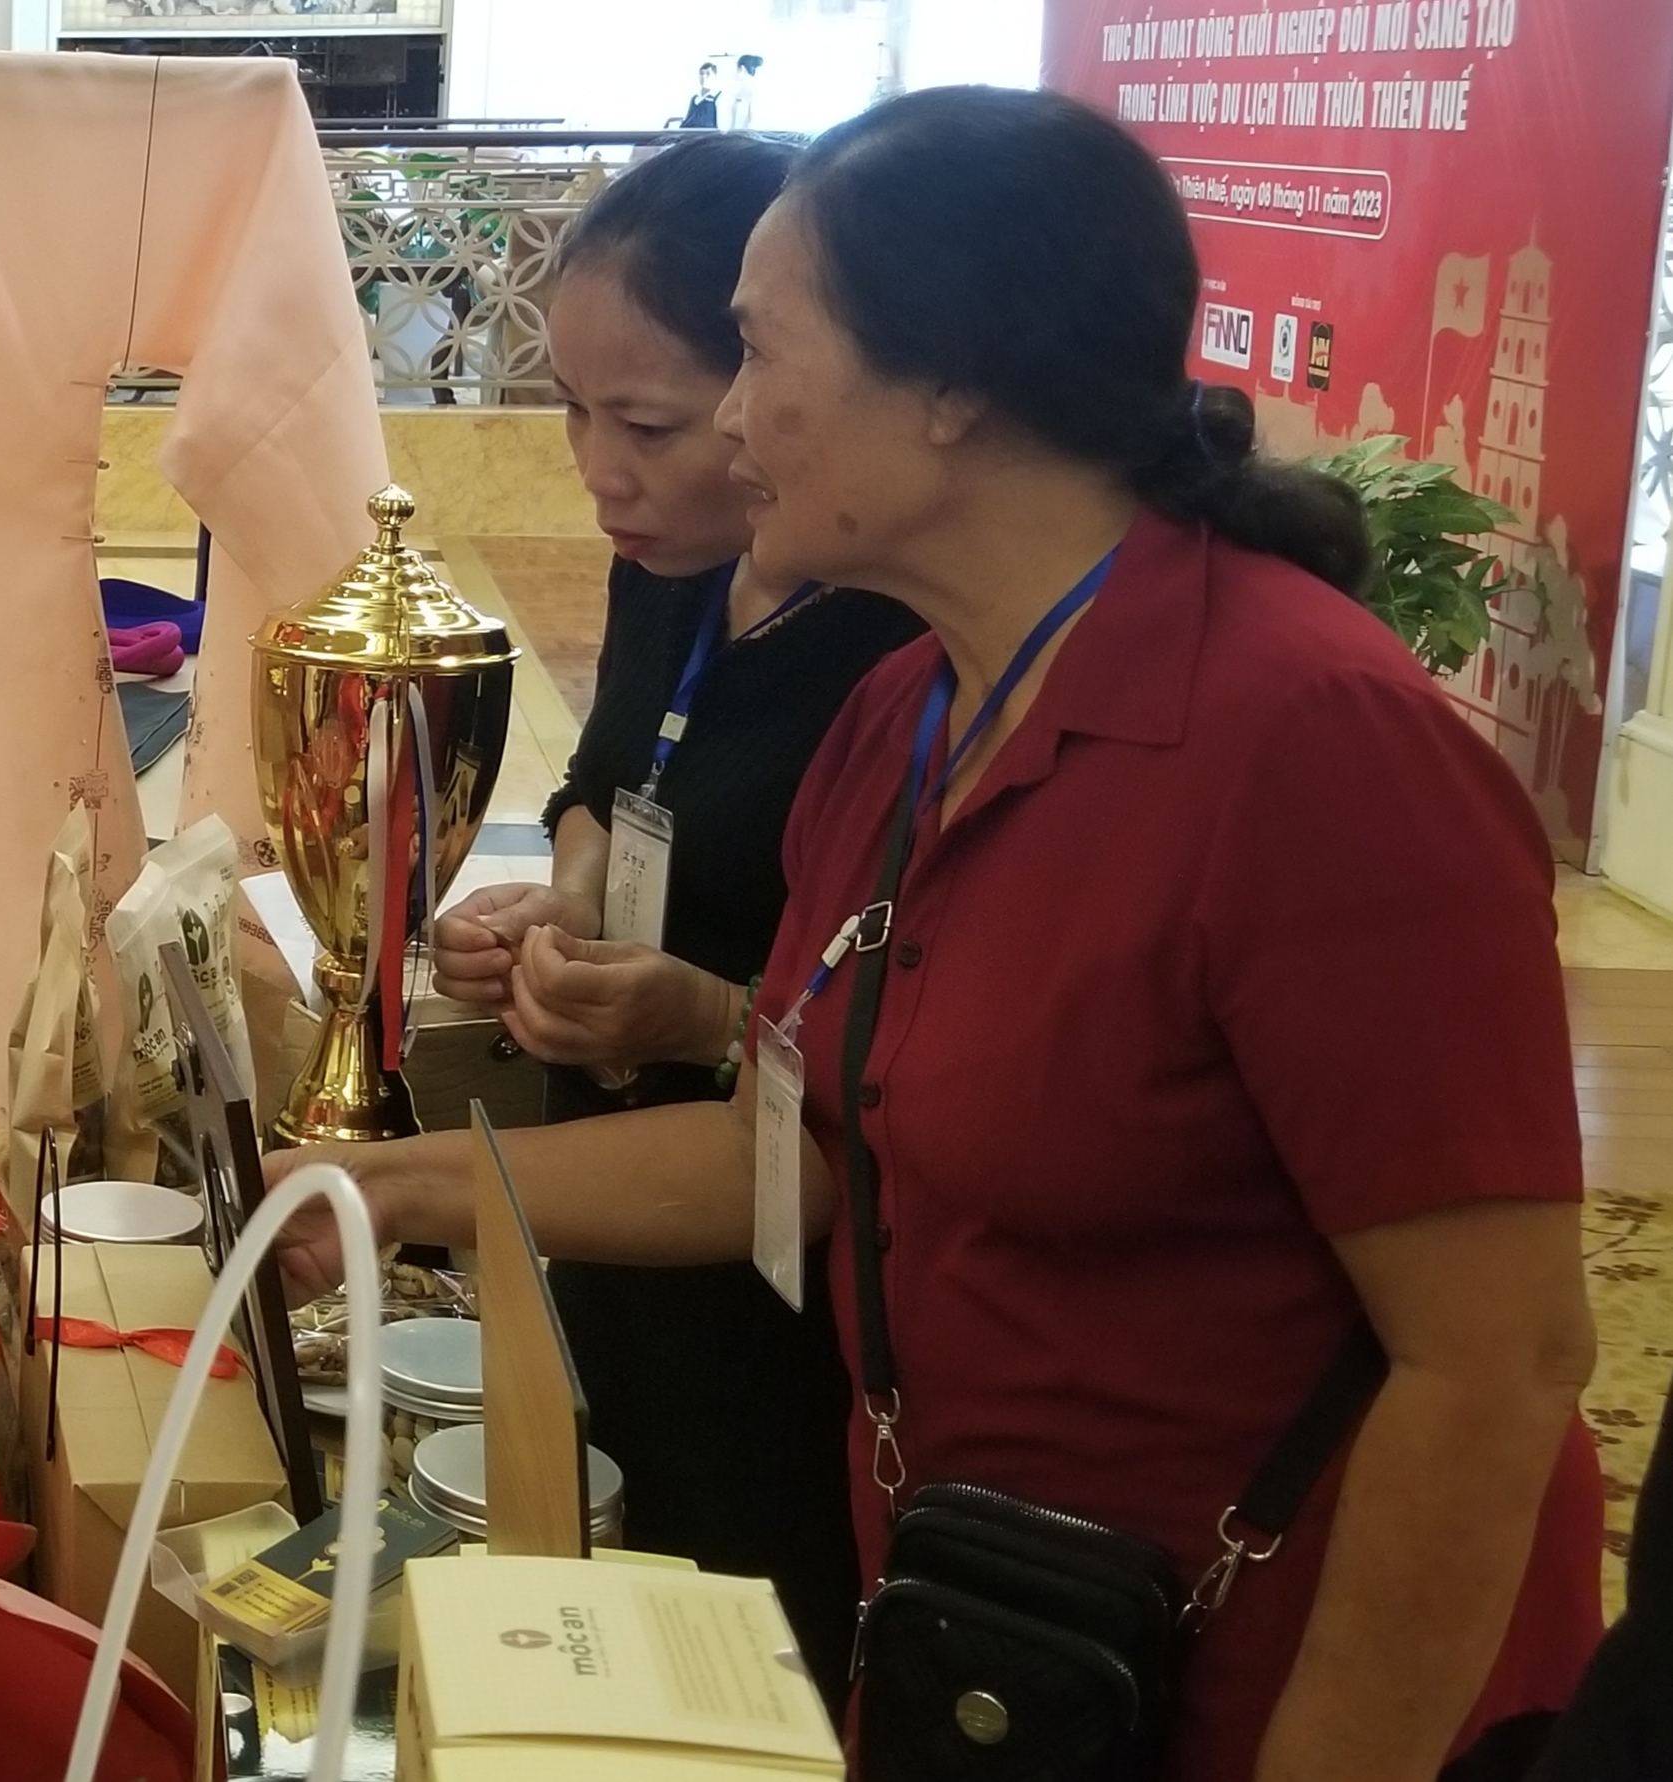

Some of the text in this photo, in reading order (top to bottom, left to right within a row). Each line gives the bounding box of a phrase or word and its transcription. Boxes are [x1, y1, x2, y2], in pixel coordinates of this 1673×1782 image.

[1102, 16, 1132, 62] THÚC
[1133, 6, 1159, 60] ĐẨY
[1160, 18, 1195, 67] HOẠT
[1195, 8, 1234, 67] ĐỘNG
[1237, 0, 1273, 57] KHỞI
[1275, 0, 1336, 64] NGHIỆP
[1475, 0, 1516, 59] TẠO
[1117, 63, 1474, 134] TRONG LĨNH VỰC DU LỊCH TỈNH THỪA THIÊN HUẾ
[1230, 178, 1256, 211] ngày
[1258, 181, 1272, 206] 08
[1273, 181, 1305, 217] tháng
[1307, 185, 1321, 212] 11
[1323, 187, 1350, 215] năm
[1352, 189, 1382, 218] 2023
